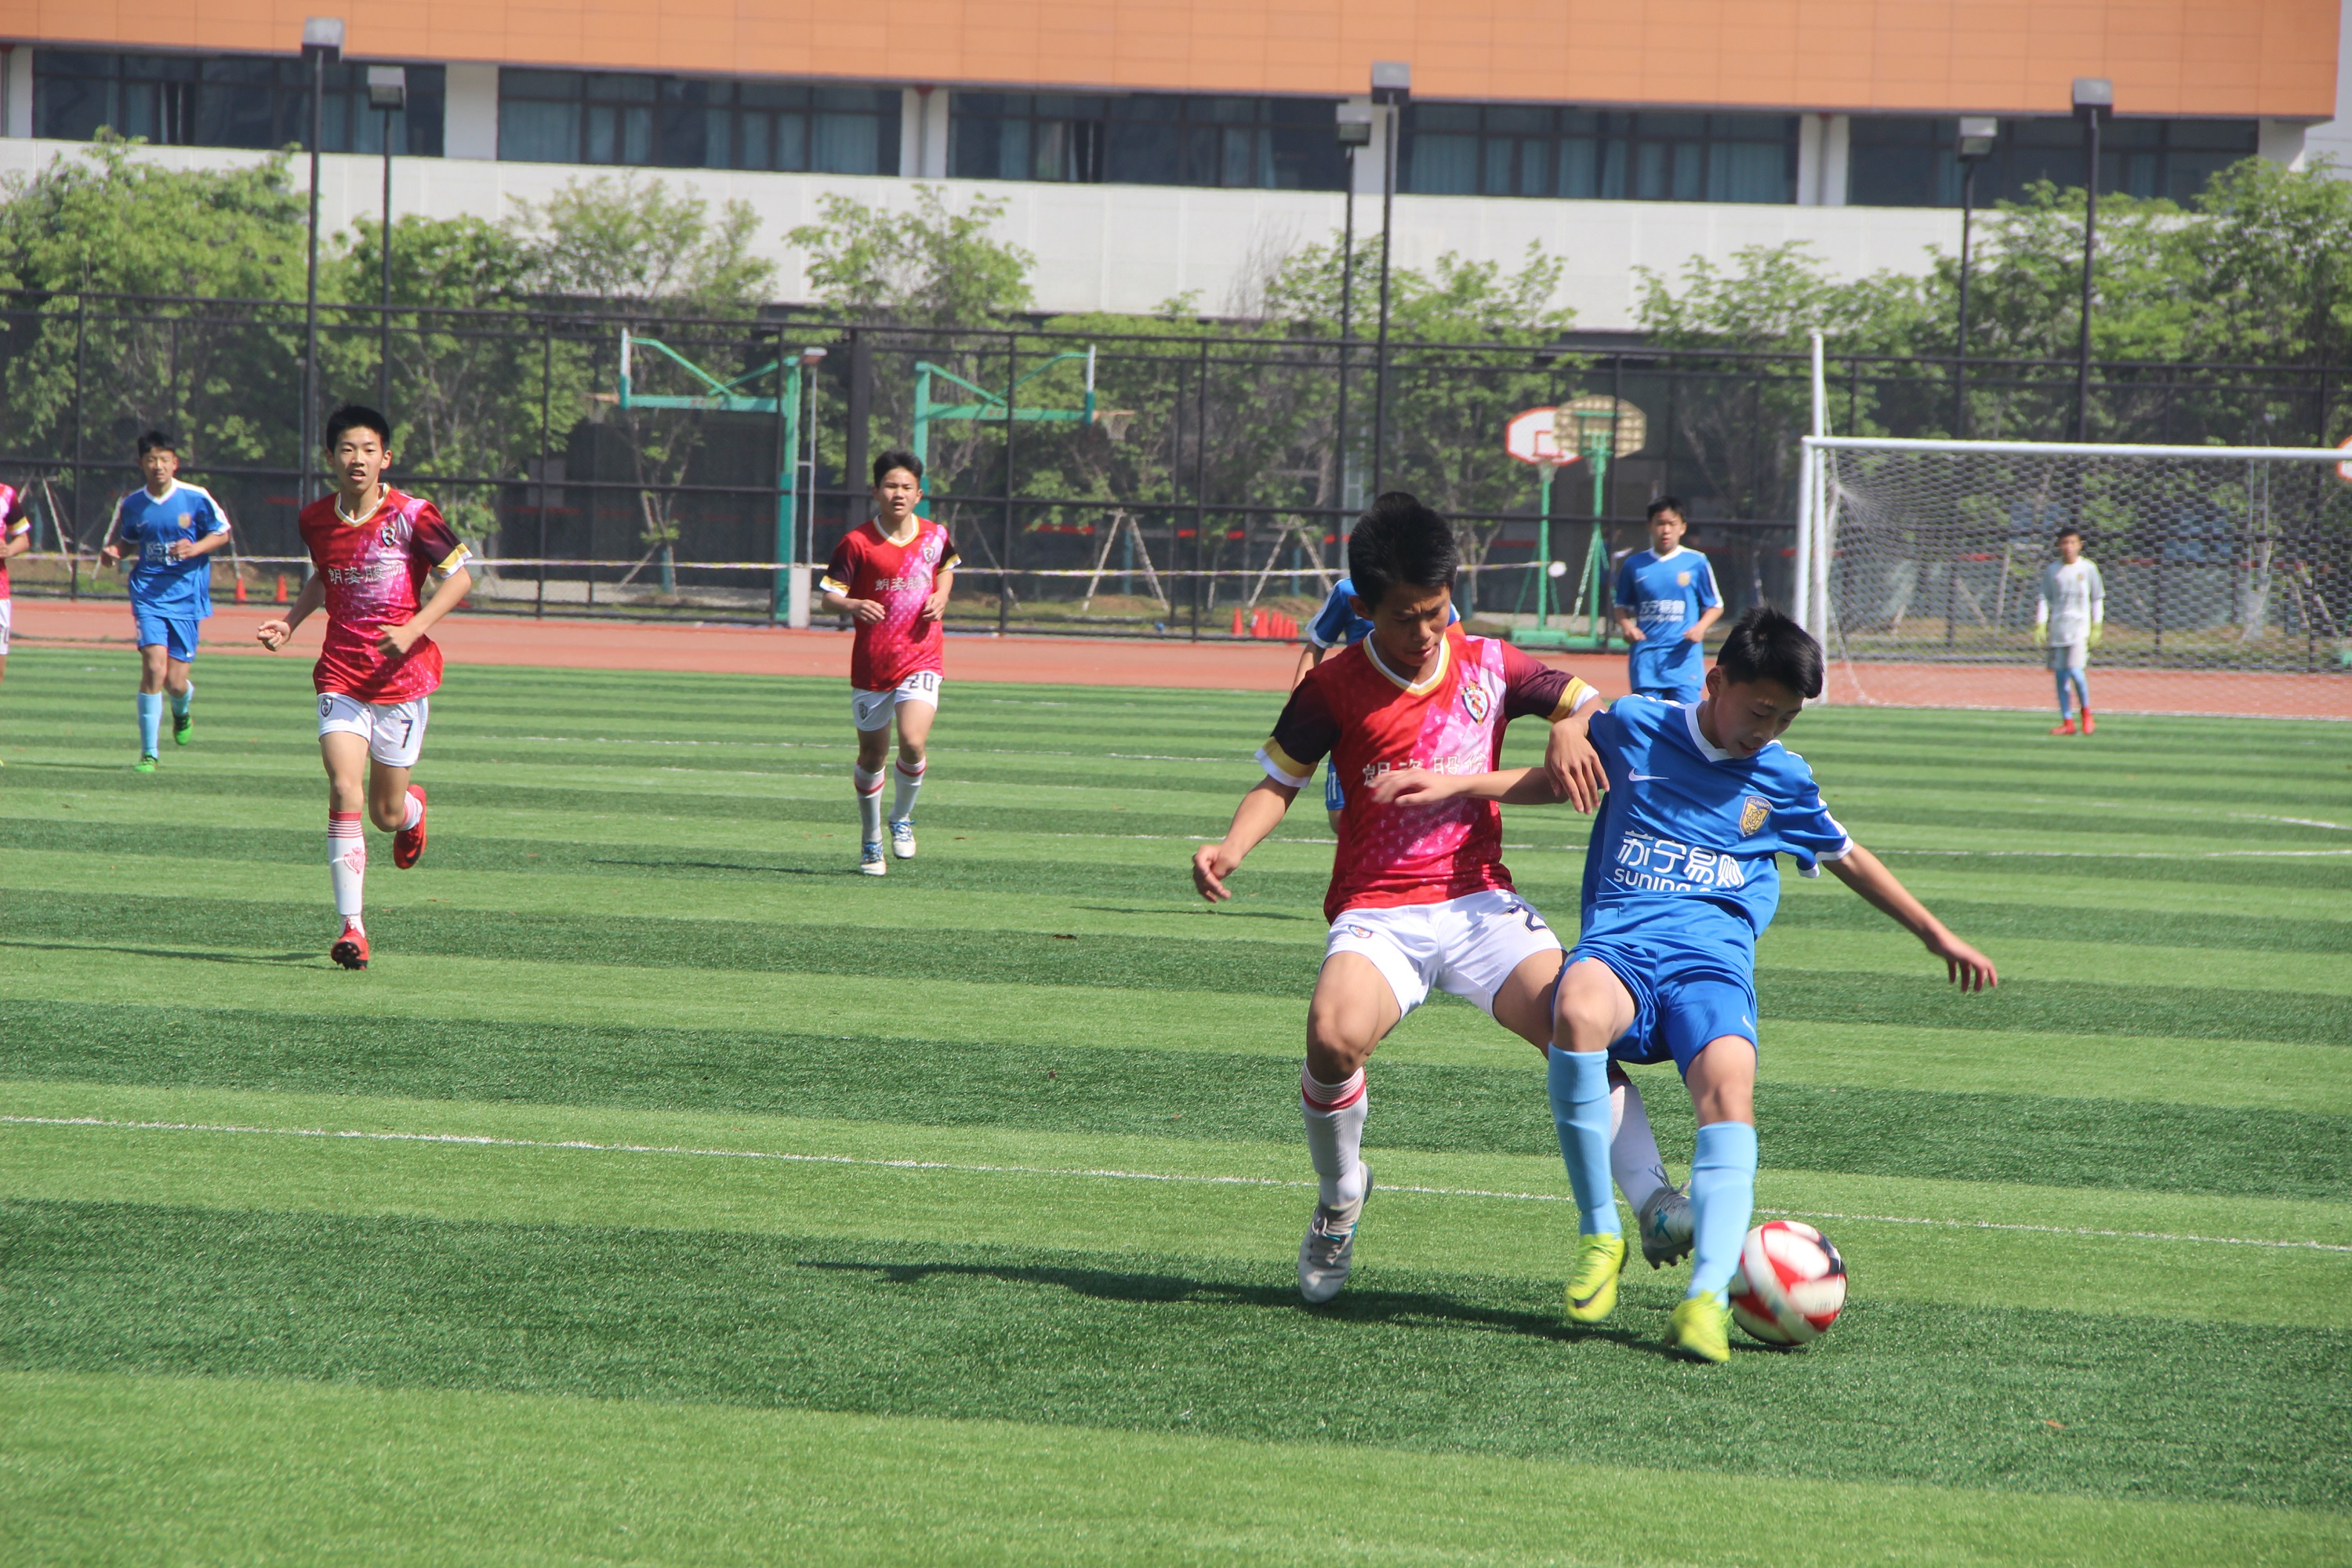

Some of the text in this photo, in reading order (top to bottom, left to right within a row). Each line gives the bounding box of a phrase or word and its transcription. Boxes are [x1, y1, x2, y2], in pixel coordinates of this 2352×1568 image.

[907, 672, 934, 692] 20
[398, 717, 413, 750] 7
[1749, 797, 1770, 809] SUNING
[1617, 830, 1745, 889] 苏宁易购
